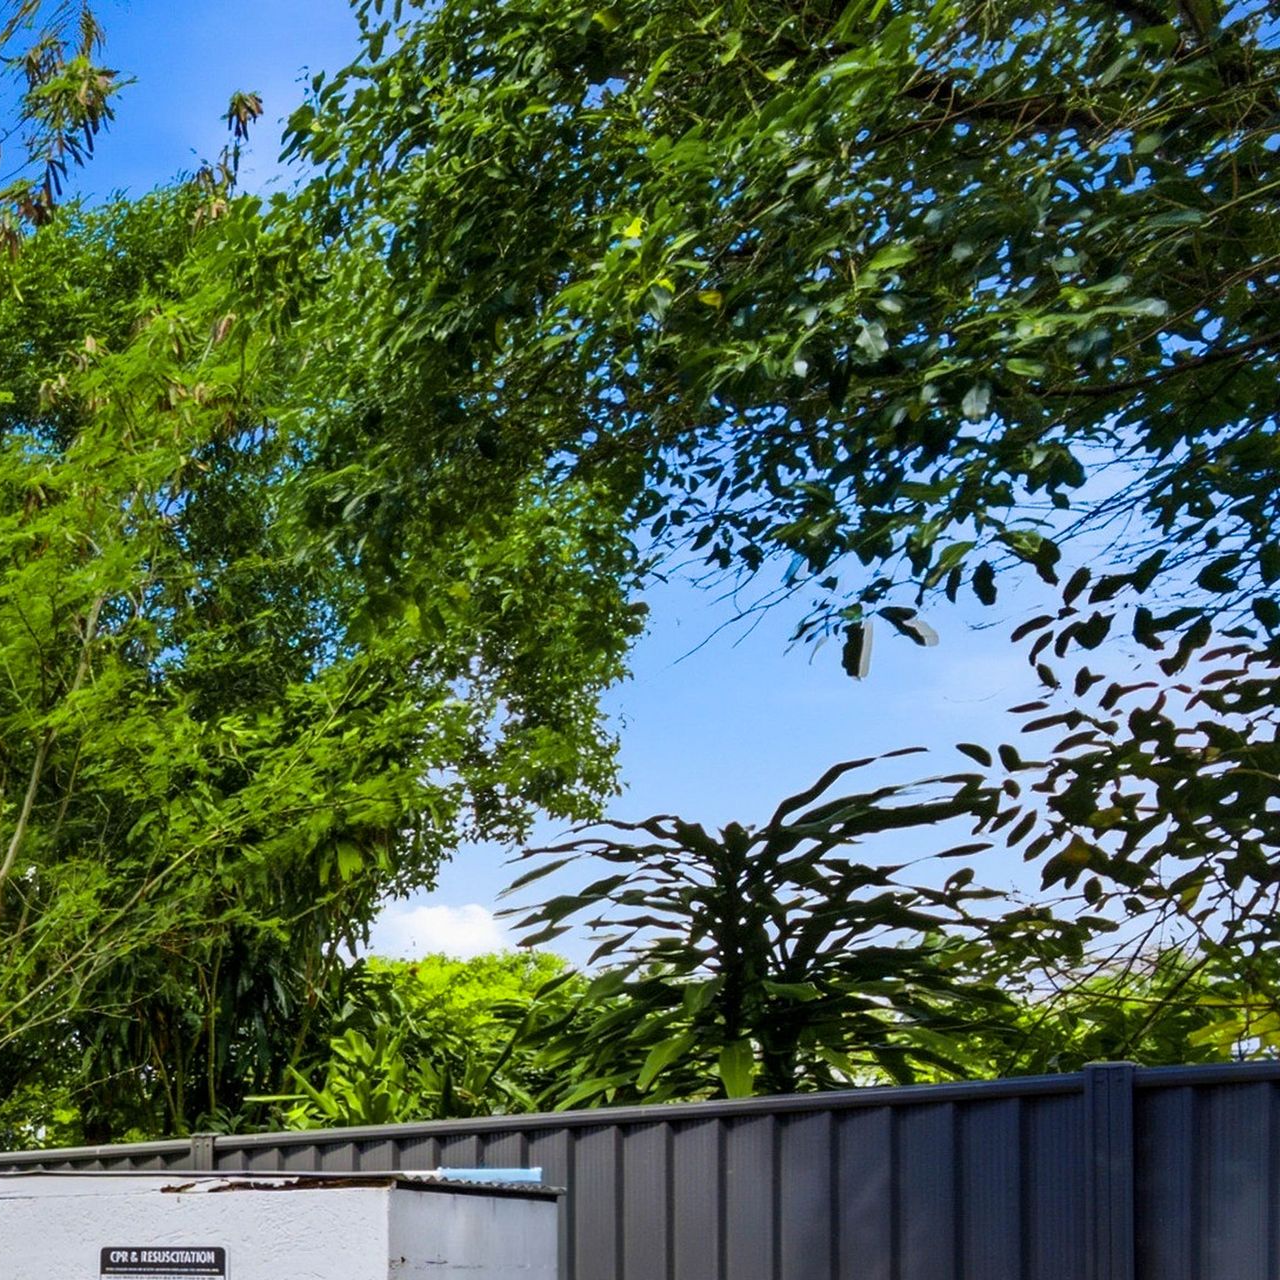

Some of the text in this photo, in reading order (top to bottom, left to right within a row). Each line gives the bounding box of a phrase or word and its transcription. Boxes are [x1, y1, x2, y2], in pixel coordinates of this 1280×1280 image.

[110, 1250, 215, 1264] CPR & RESUSCITATION
